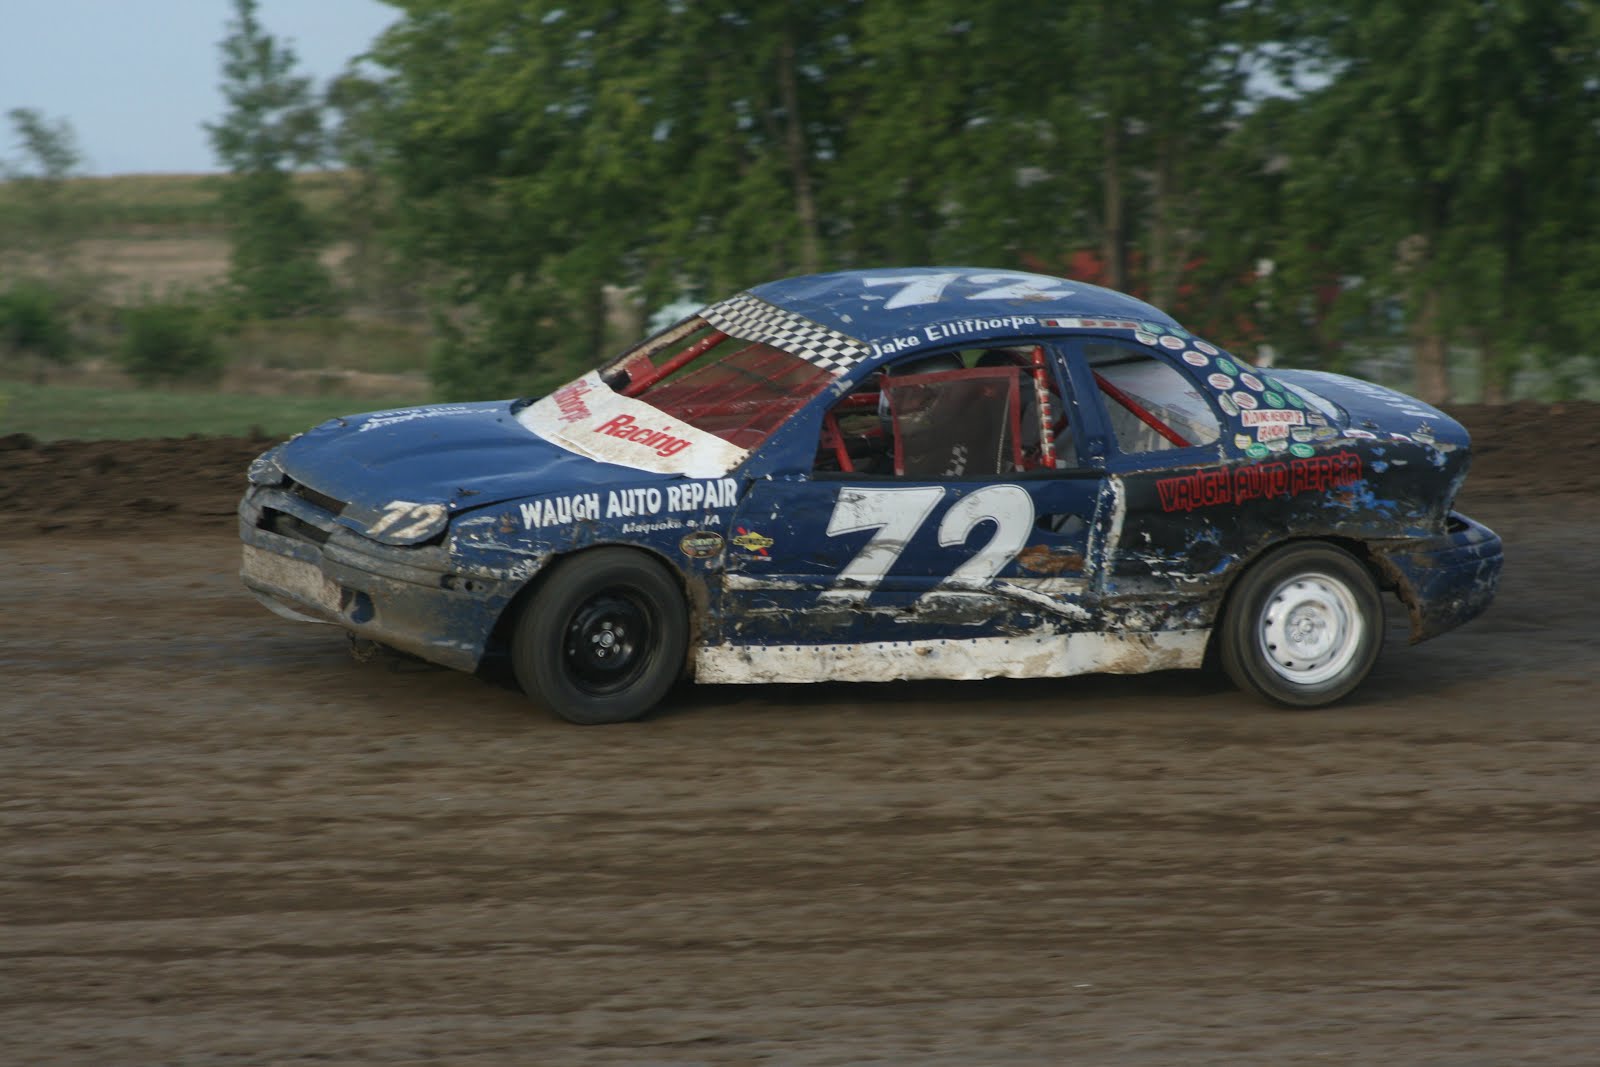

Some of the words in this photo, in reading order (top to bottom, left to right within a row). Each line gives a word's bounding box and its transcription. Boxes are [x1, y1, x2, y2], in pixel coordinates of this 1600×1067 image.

[862, 273, 1077, 310] 72
[870, 335, 921, 360] Jake
[924, 315, 1038, 342] Ellithorpe
[593, 414, 693, 457] Racing
[520, 493, 600, 530] WAUGH
[606, 487, 662, 519] AUTO
[667, 478, 738, 513] REPAIR
[1156, 465, 1230, 512] WAUGH
[1234, 462, 1288, 505] AUTO
[1290, 451, 1361, 496] REPAIR
[366, 501, 447, 538] 72
[817, 484, 1035, 612] 72
